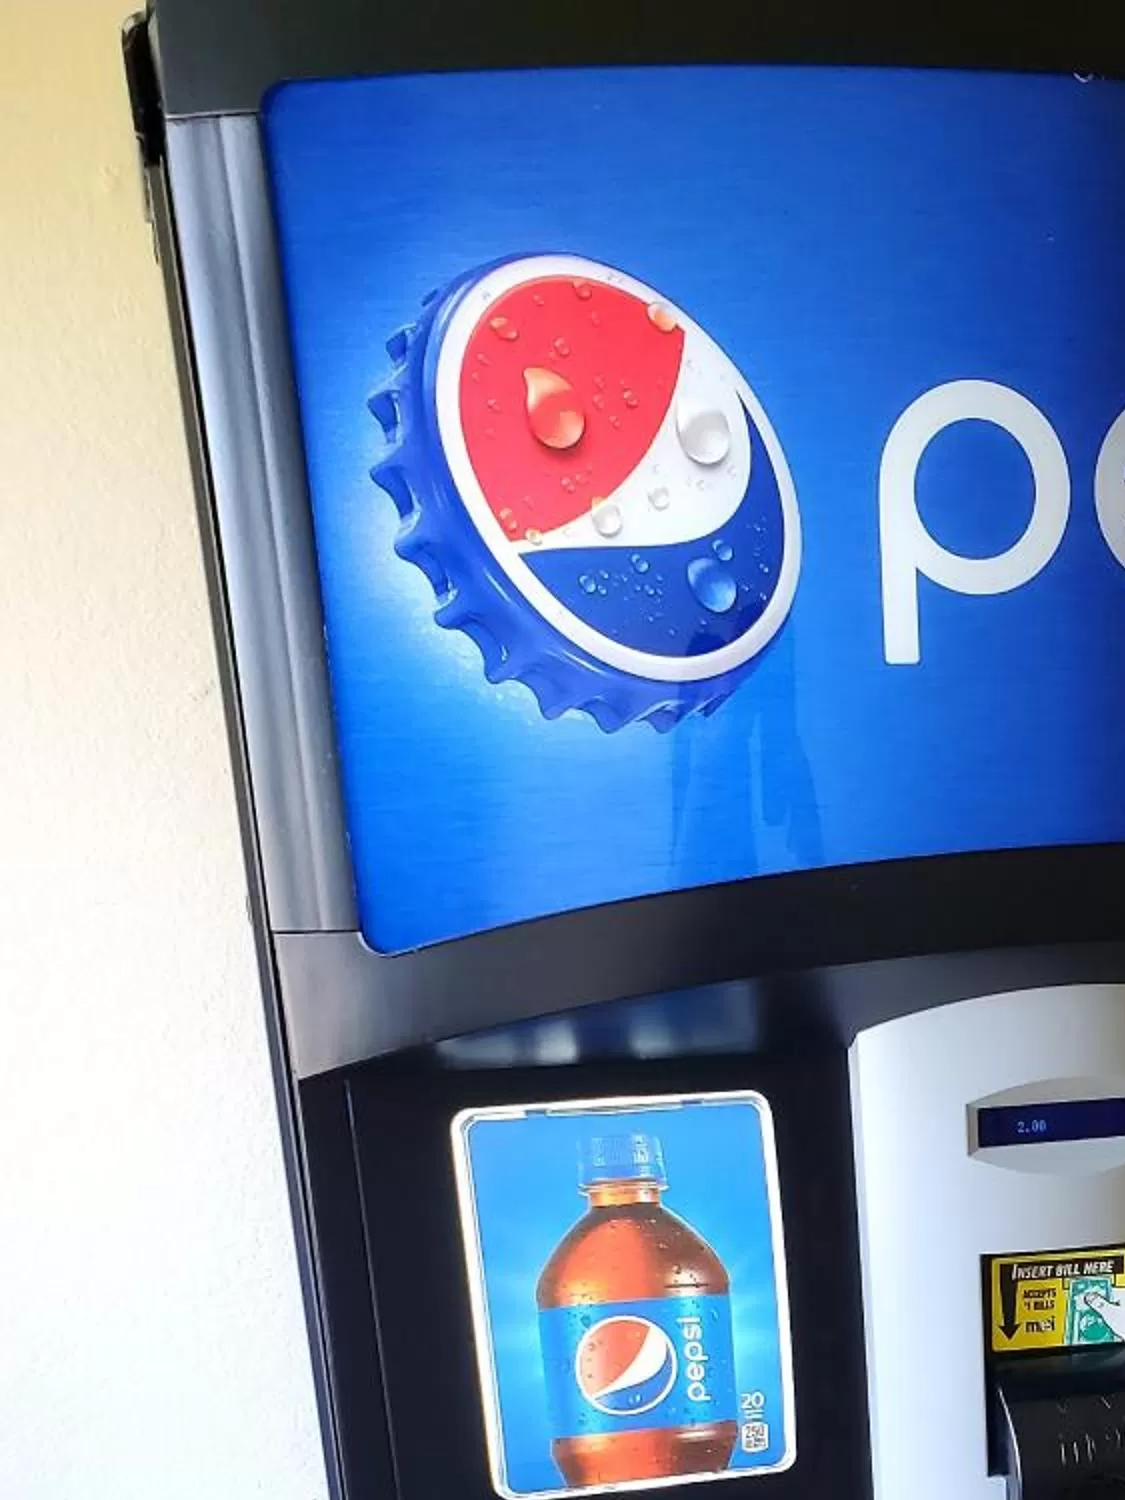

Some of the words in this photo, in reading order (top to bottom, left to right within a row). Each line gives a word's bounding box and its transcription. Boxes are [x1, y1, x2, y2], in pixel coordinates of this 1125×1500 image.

[1017, 1119, 1047, 1133] 2.00
[1011, 1263, 1053, 1280] INSERT
[1055, 1262, 1081, 1277] BILL
[1083, 1260, 1115, 1275] HERE
[676, 1316, 711, 1402] pepsi
[740, 1391, 765, 1409] 20
